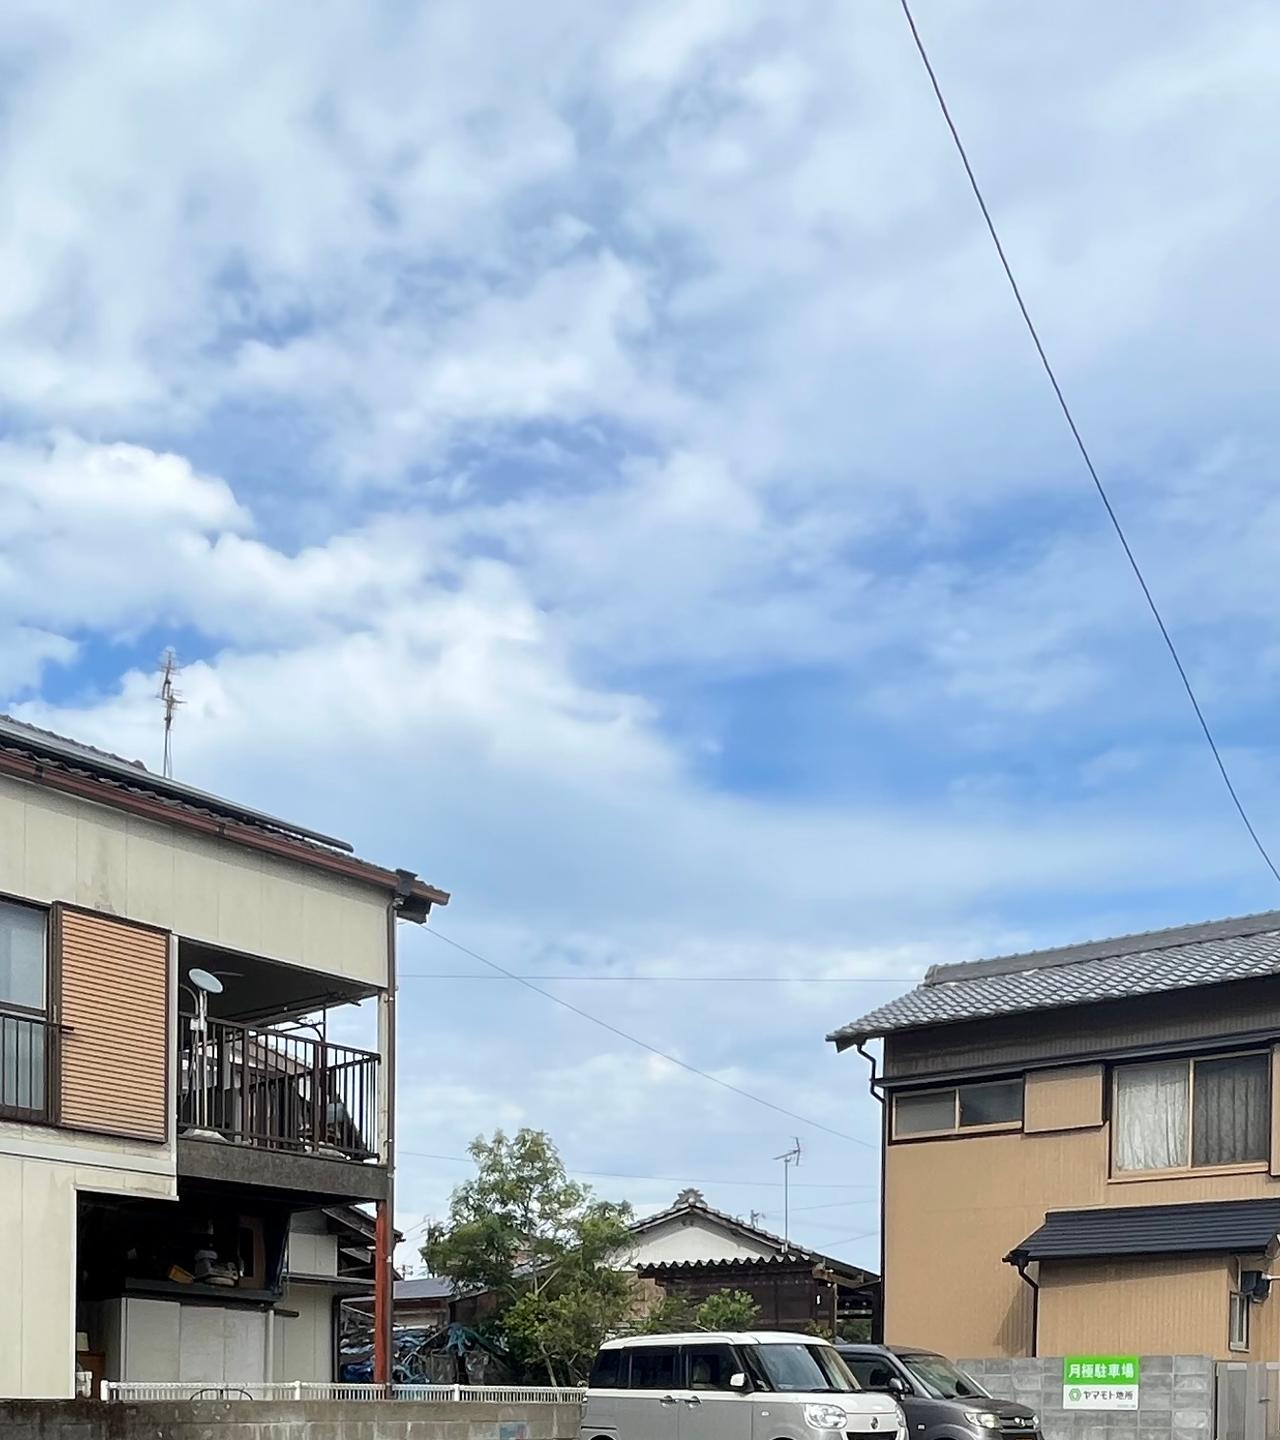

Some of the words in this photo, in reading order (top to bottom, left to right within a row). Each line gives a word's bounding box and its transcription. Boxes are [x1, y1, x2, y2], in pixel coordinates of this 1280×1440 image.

[1068, 1363, 1134, 1379] 月極駐車場
